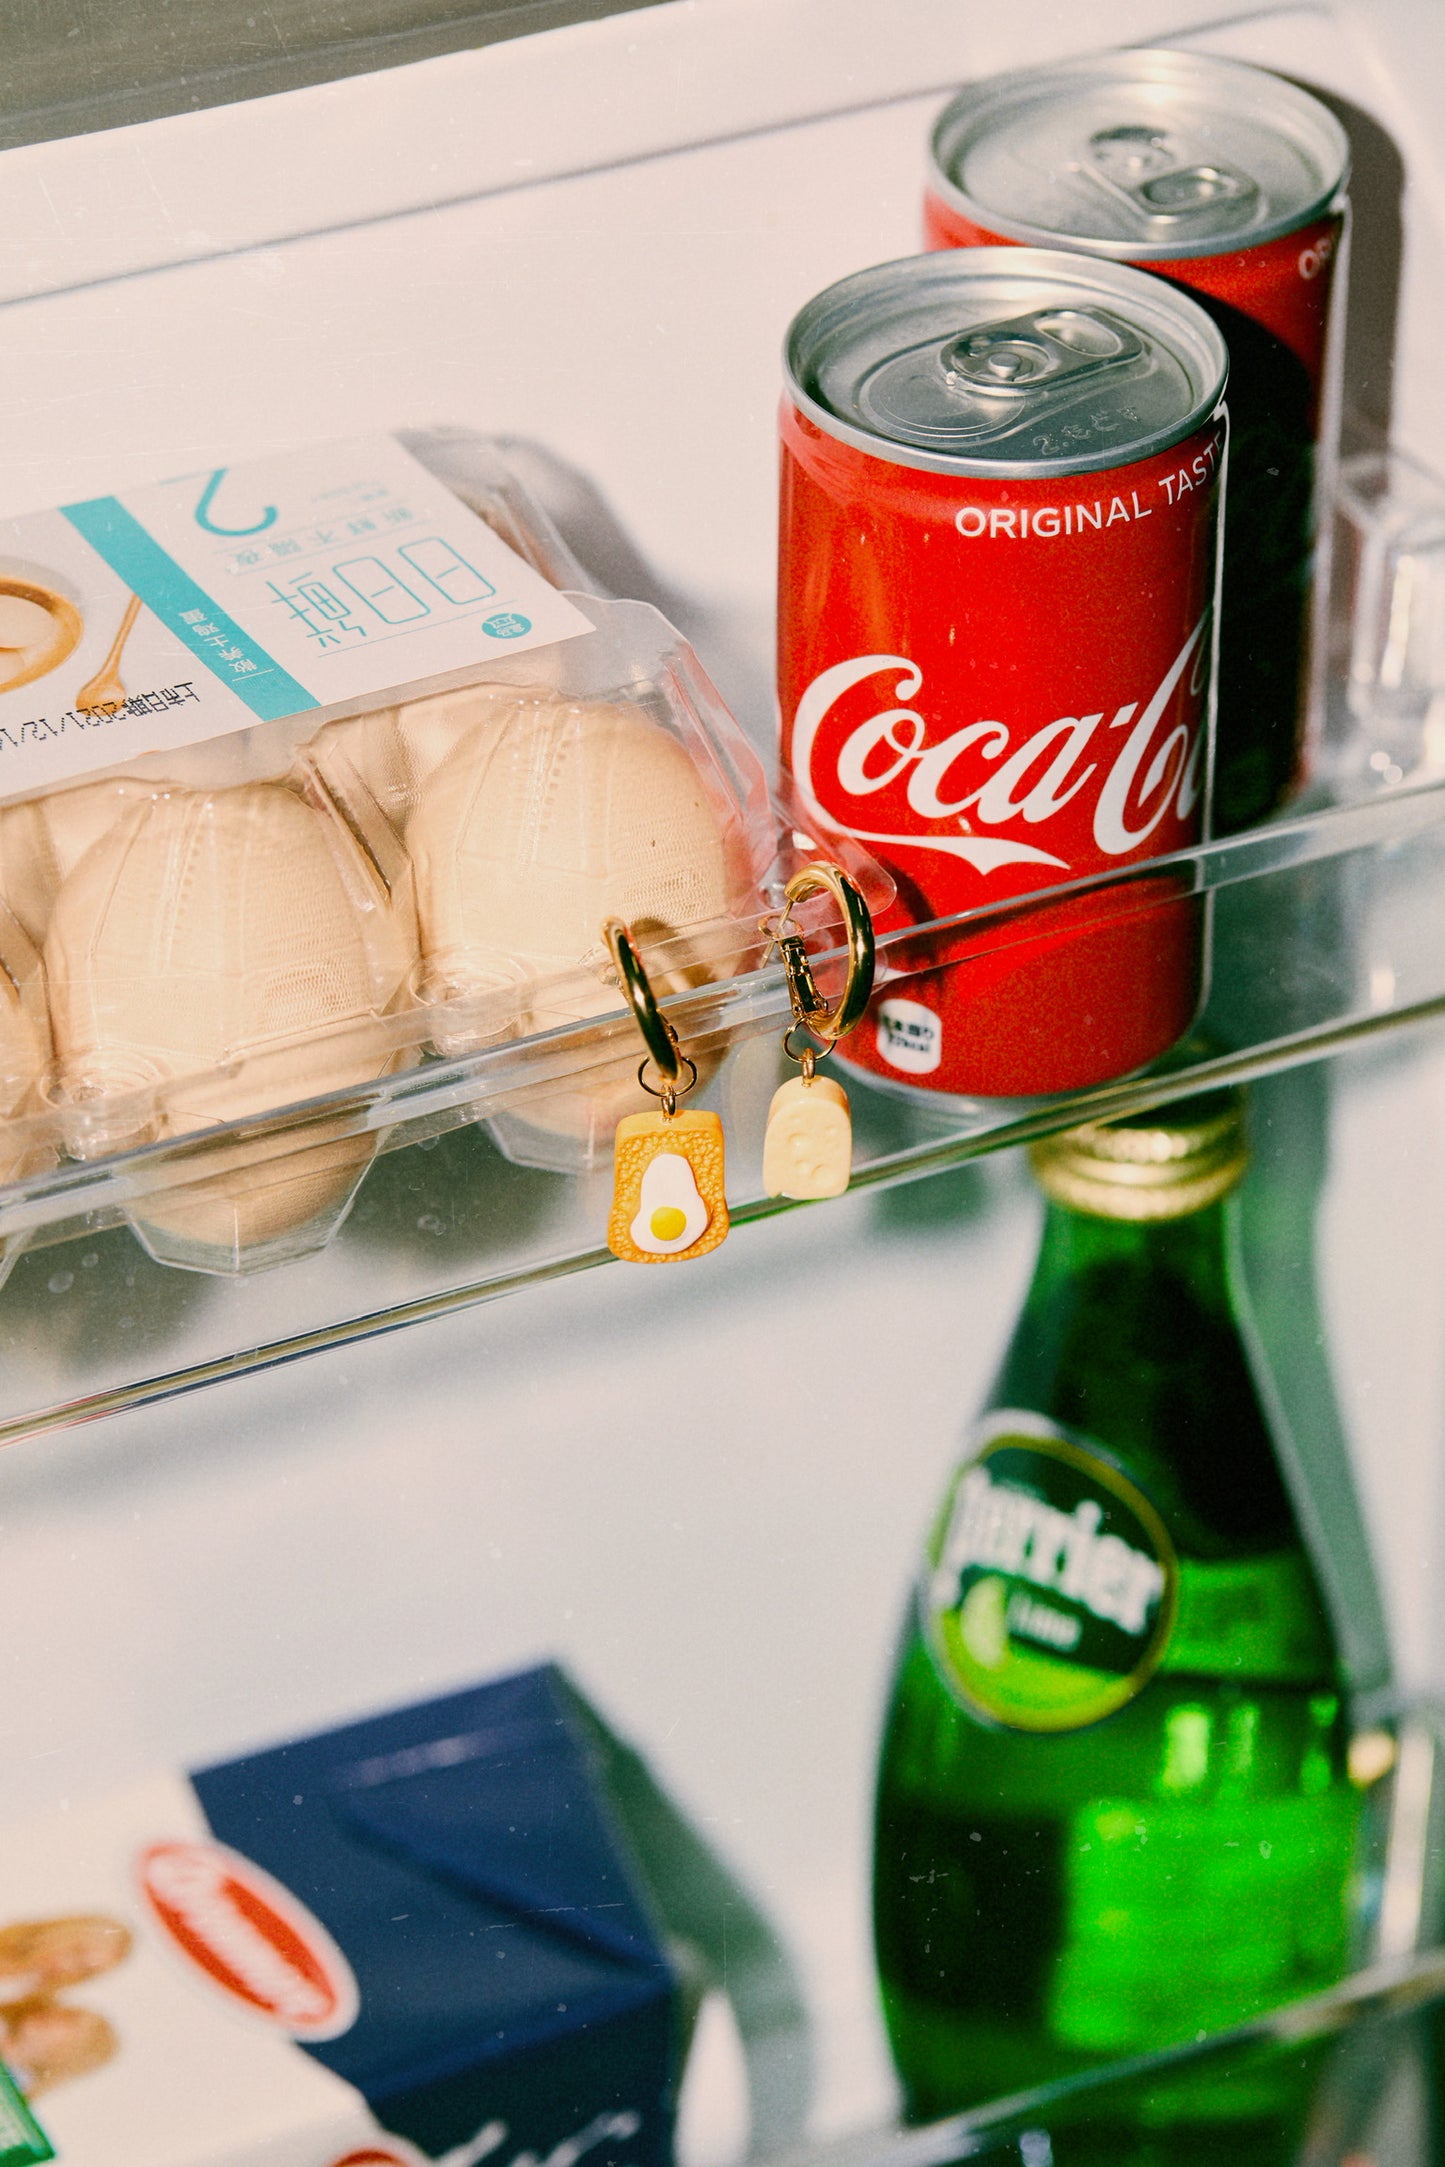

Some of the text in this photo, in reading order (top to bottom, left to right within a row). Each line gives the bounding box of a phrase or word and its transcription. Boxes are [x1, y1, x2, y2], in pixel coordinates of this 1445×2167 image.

[955, 491, 1153, 539] ORIGINAL
[0, 682, 201, 751] 上市日期:2021/12/1
